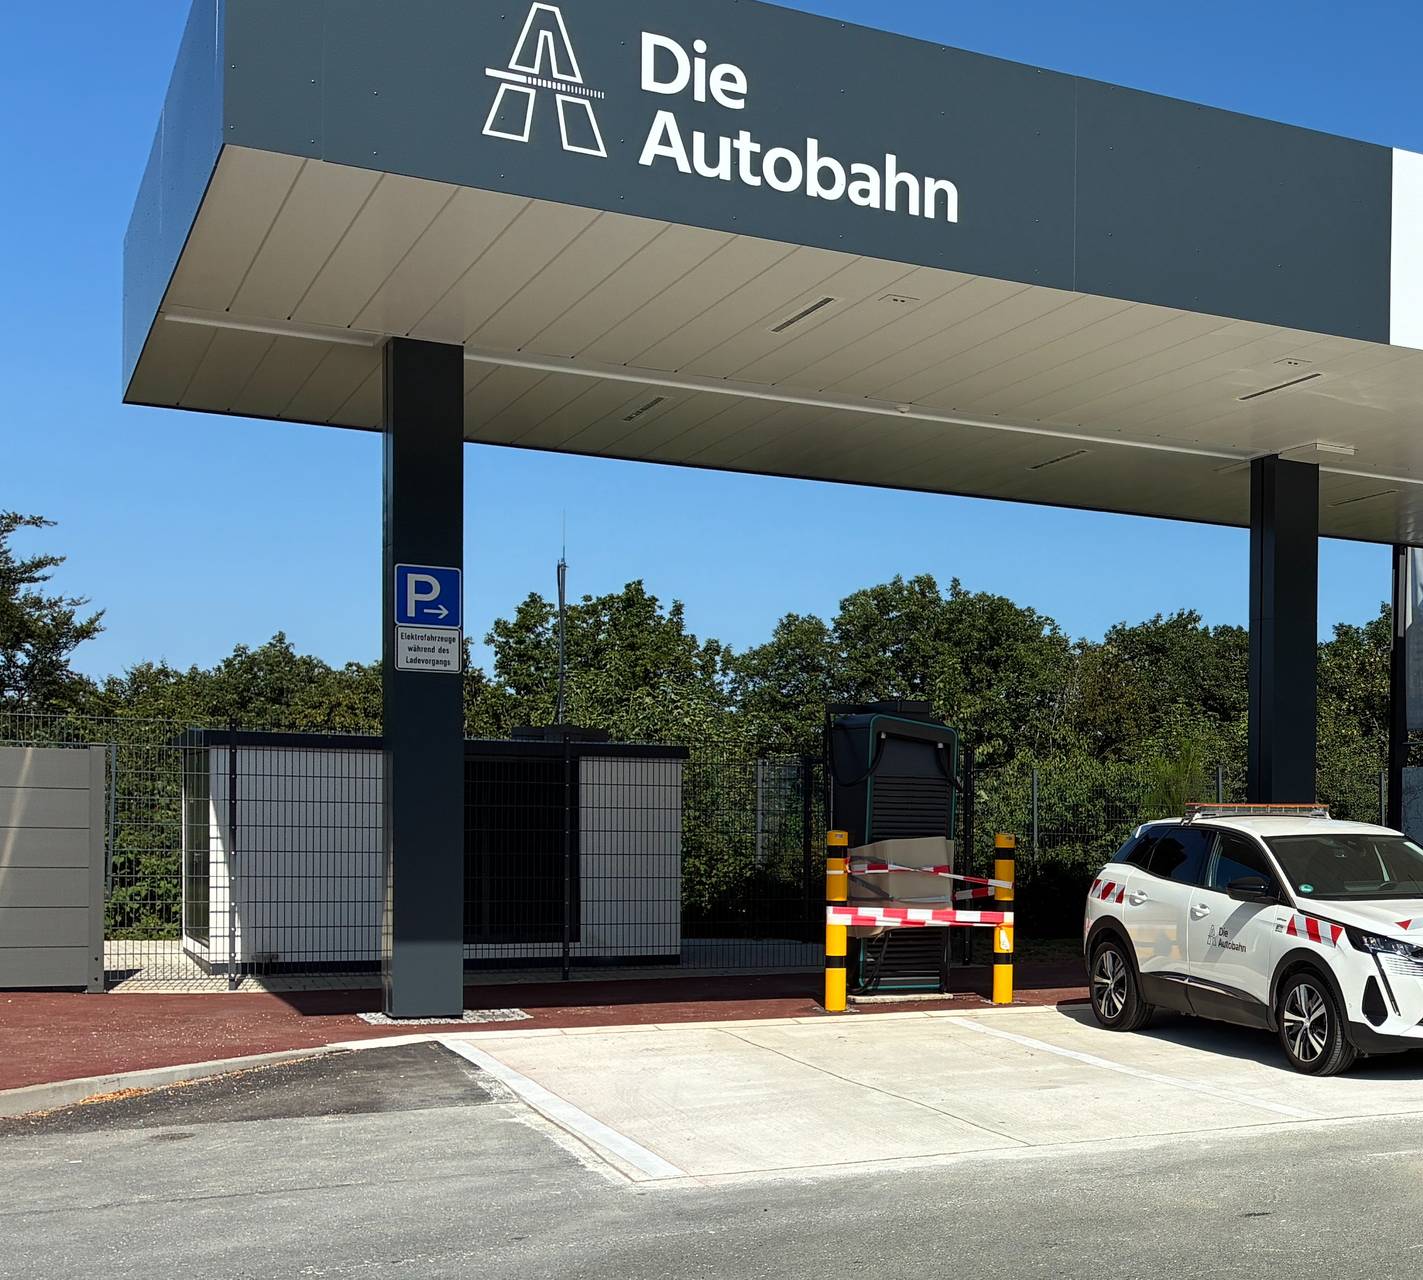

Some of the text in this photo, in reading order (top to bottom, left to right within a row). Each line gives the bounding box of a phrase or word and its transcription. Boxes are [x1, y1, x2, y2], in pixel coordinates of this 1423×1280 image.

[640, 31, 748, 110] Die
[638, 109, 958, 224] Autobahn
[407, 573, 441, 617] P
[400, 632, 456, 644] Elektrofahrzeuge
[407, 644, 450, 654] während des
[405, 656, 451, 667] Ladevorgangs
[1218, 927, 1229, 937] Die
[1218, 939, 1247, 952] Autobahn
